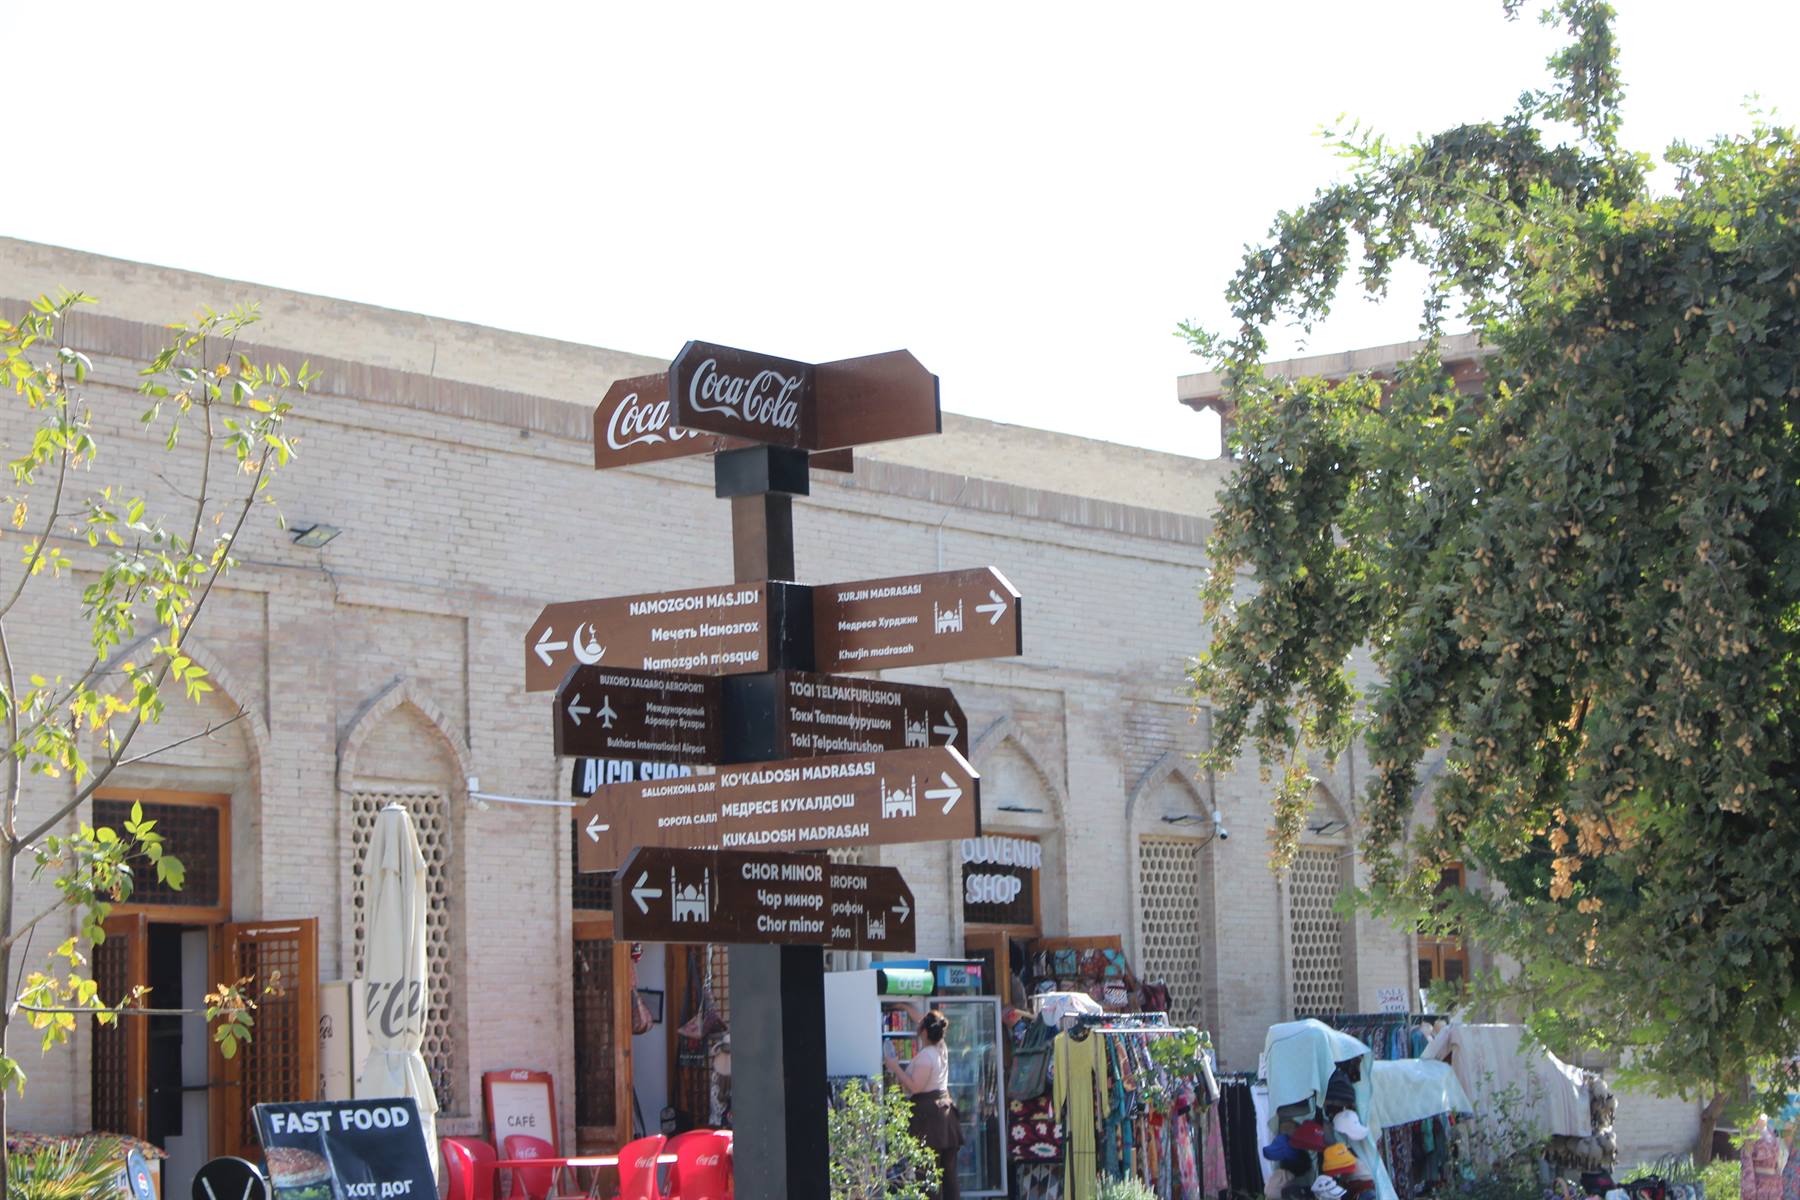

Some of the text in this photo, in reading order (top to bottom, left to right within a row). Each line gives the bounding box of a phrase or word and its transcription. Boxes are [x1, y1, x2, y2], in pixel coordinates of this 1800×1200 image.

[689, 358, 803, 429] Coca-Cola
[629, 590, 759, 616] NAMOZGOH MASJIDI
[837, 584, 922, 603] XURJIN MADRASASI
[651, 621, 759, 642] Мечеть Намозгох
[838, 615, 918, 632] Медресе Хурджин
[643, 650, 760, 671] Namozgoh mosque
[839, 643, 914, 661] Khurjin madrasah
[600, 674, 704, 693] BUXORO XALQARO AEROPORTI
[790, 681, 901, 706] TOQI TELPAKFURUSHON
[790, 707, 892, 731] Токи Телпакфурушон
[607, 736, 706, 755] Bukhara International Airport
[791, 732, 884, 753] Toki Telpakfurushon
[802, 761, 876, 781] MADRASASI
[641, 783, 696, 798] SALLOHXONA
[721, 794, 855, 818] МЕДРЕСЕ КУКАЛДОШ
[658, 816, 692, 828] ВОРОТА
[722, 823, 869, 847] KUKALDOSH MADRASAH
[742, 862, 823, 882] CHOR MINOR
[965, 873, 1022, 904] SHOP
[757, 889, 824, 911] Чор минор
[831, 900, 863, 916] рофон
[757, 915, 825, 934] Chor minor
[270, 1106, 410, 1134] FAST FOOD
[345, 1179, 413, 1198] ХОТ ДОГ
